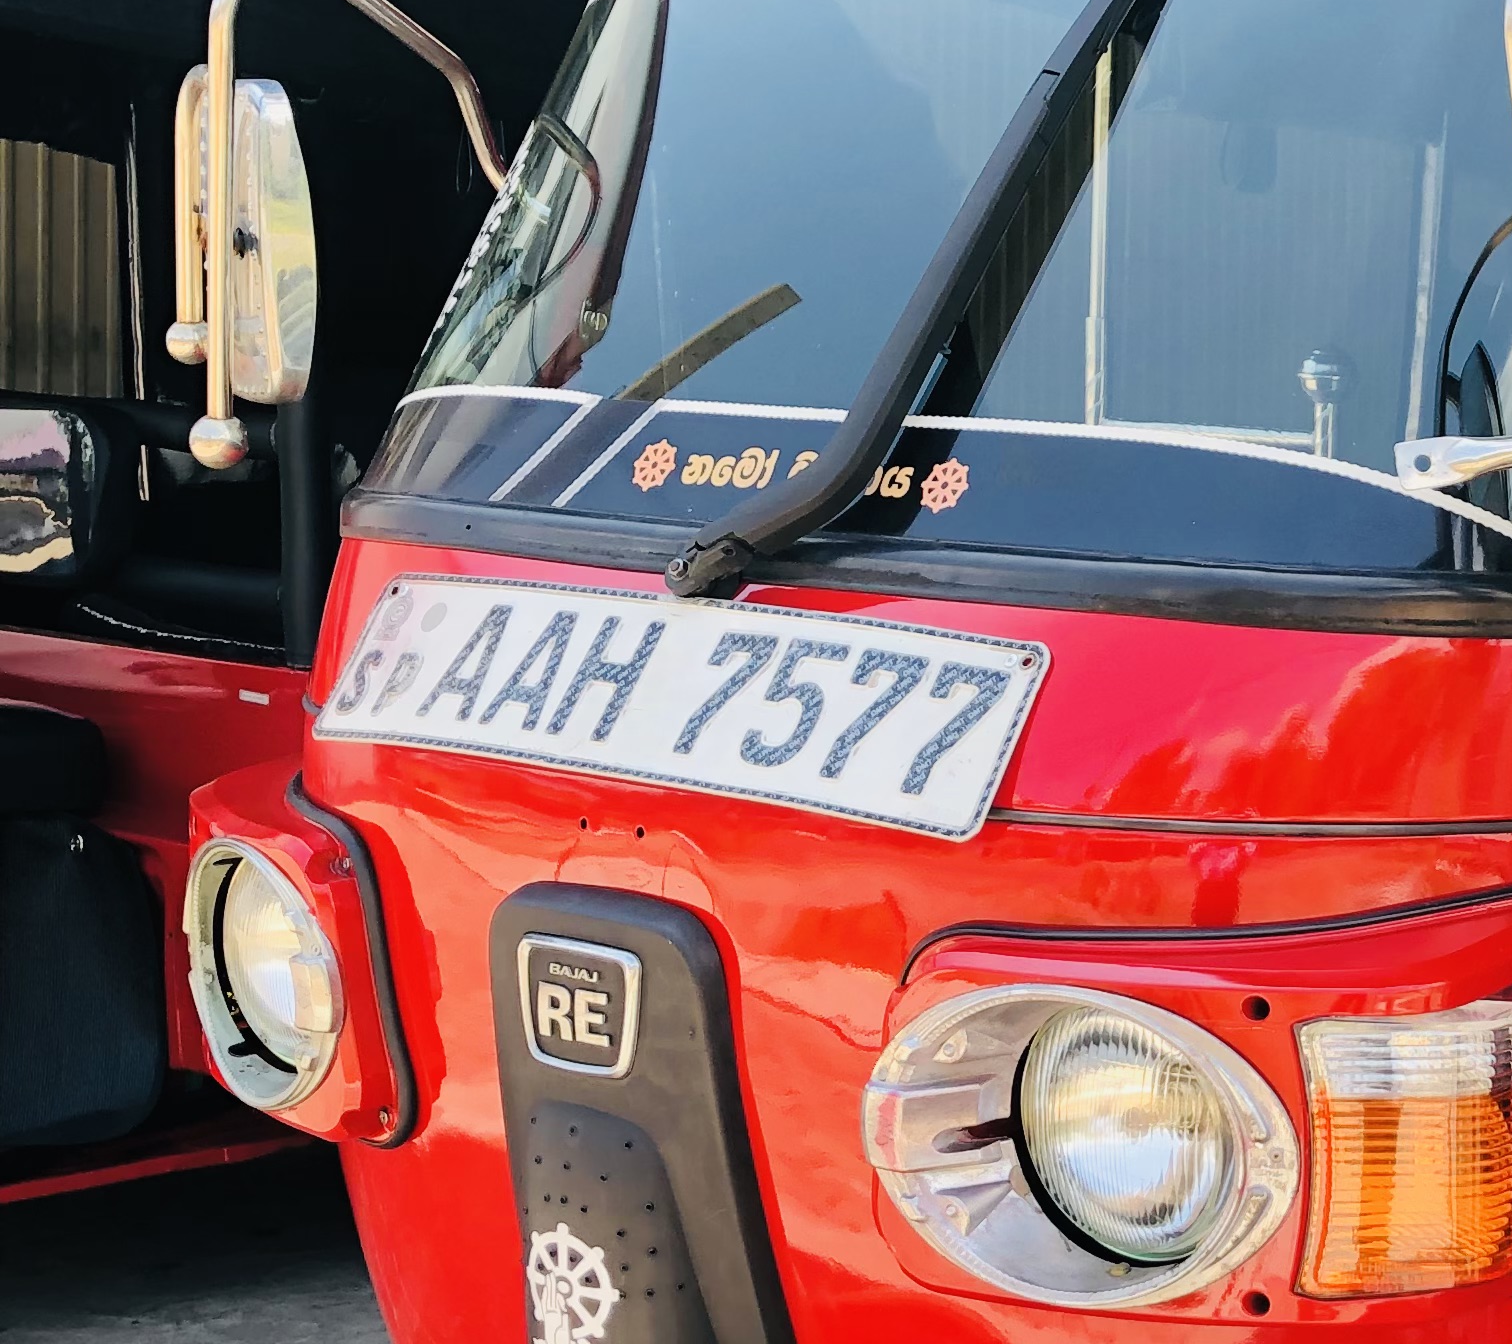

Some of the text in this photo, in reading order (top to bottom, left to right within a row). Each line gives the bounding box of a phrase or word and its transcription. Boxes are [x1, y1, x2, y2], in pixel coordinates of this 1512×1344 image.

[680, 446, 781, 491] නමෝ
[335, 604, 1012, 795] SP AAH 7577
[549, 962, 600, 984] BAJAJ
[536, 980, 611, 1048] RE
